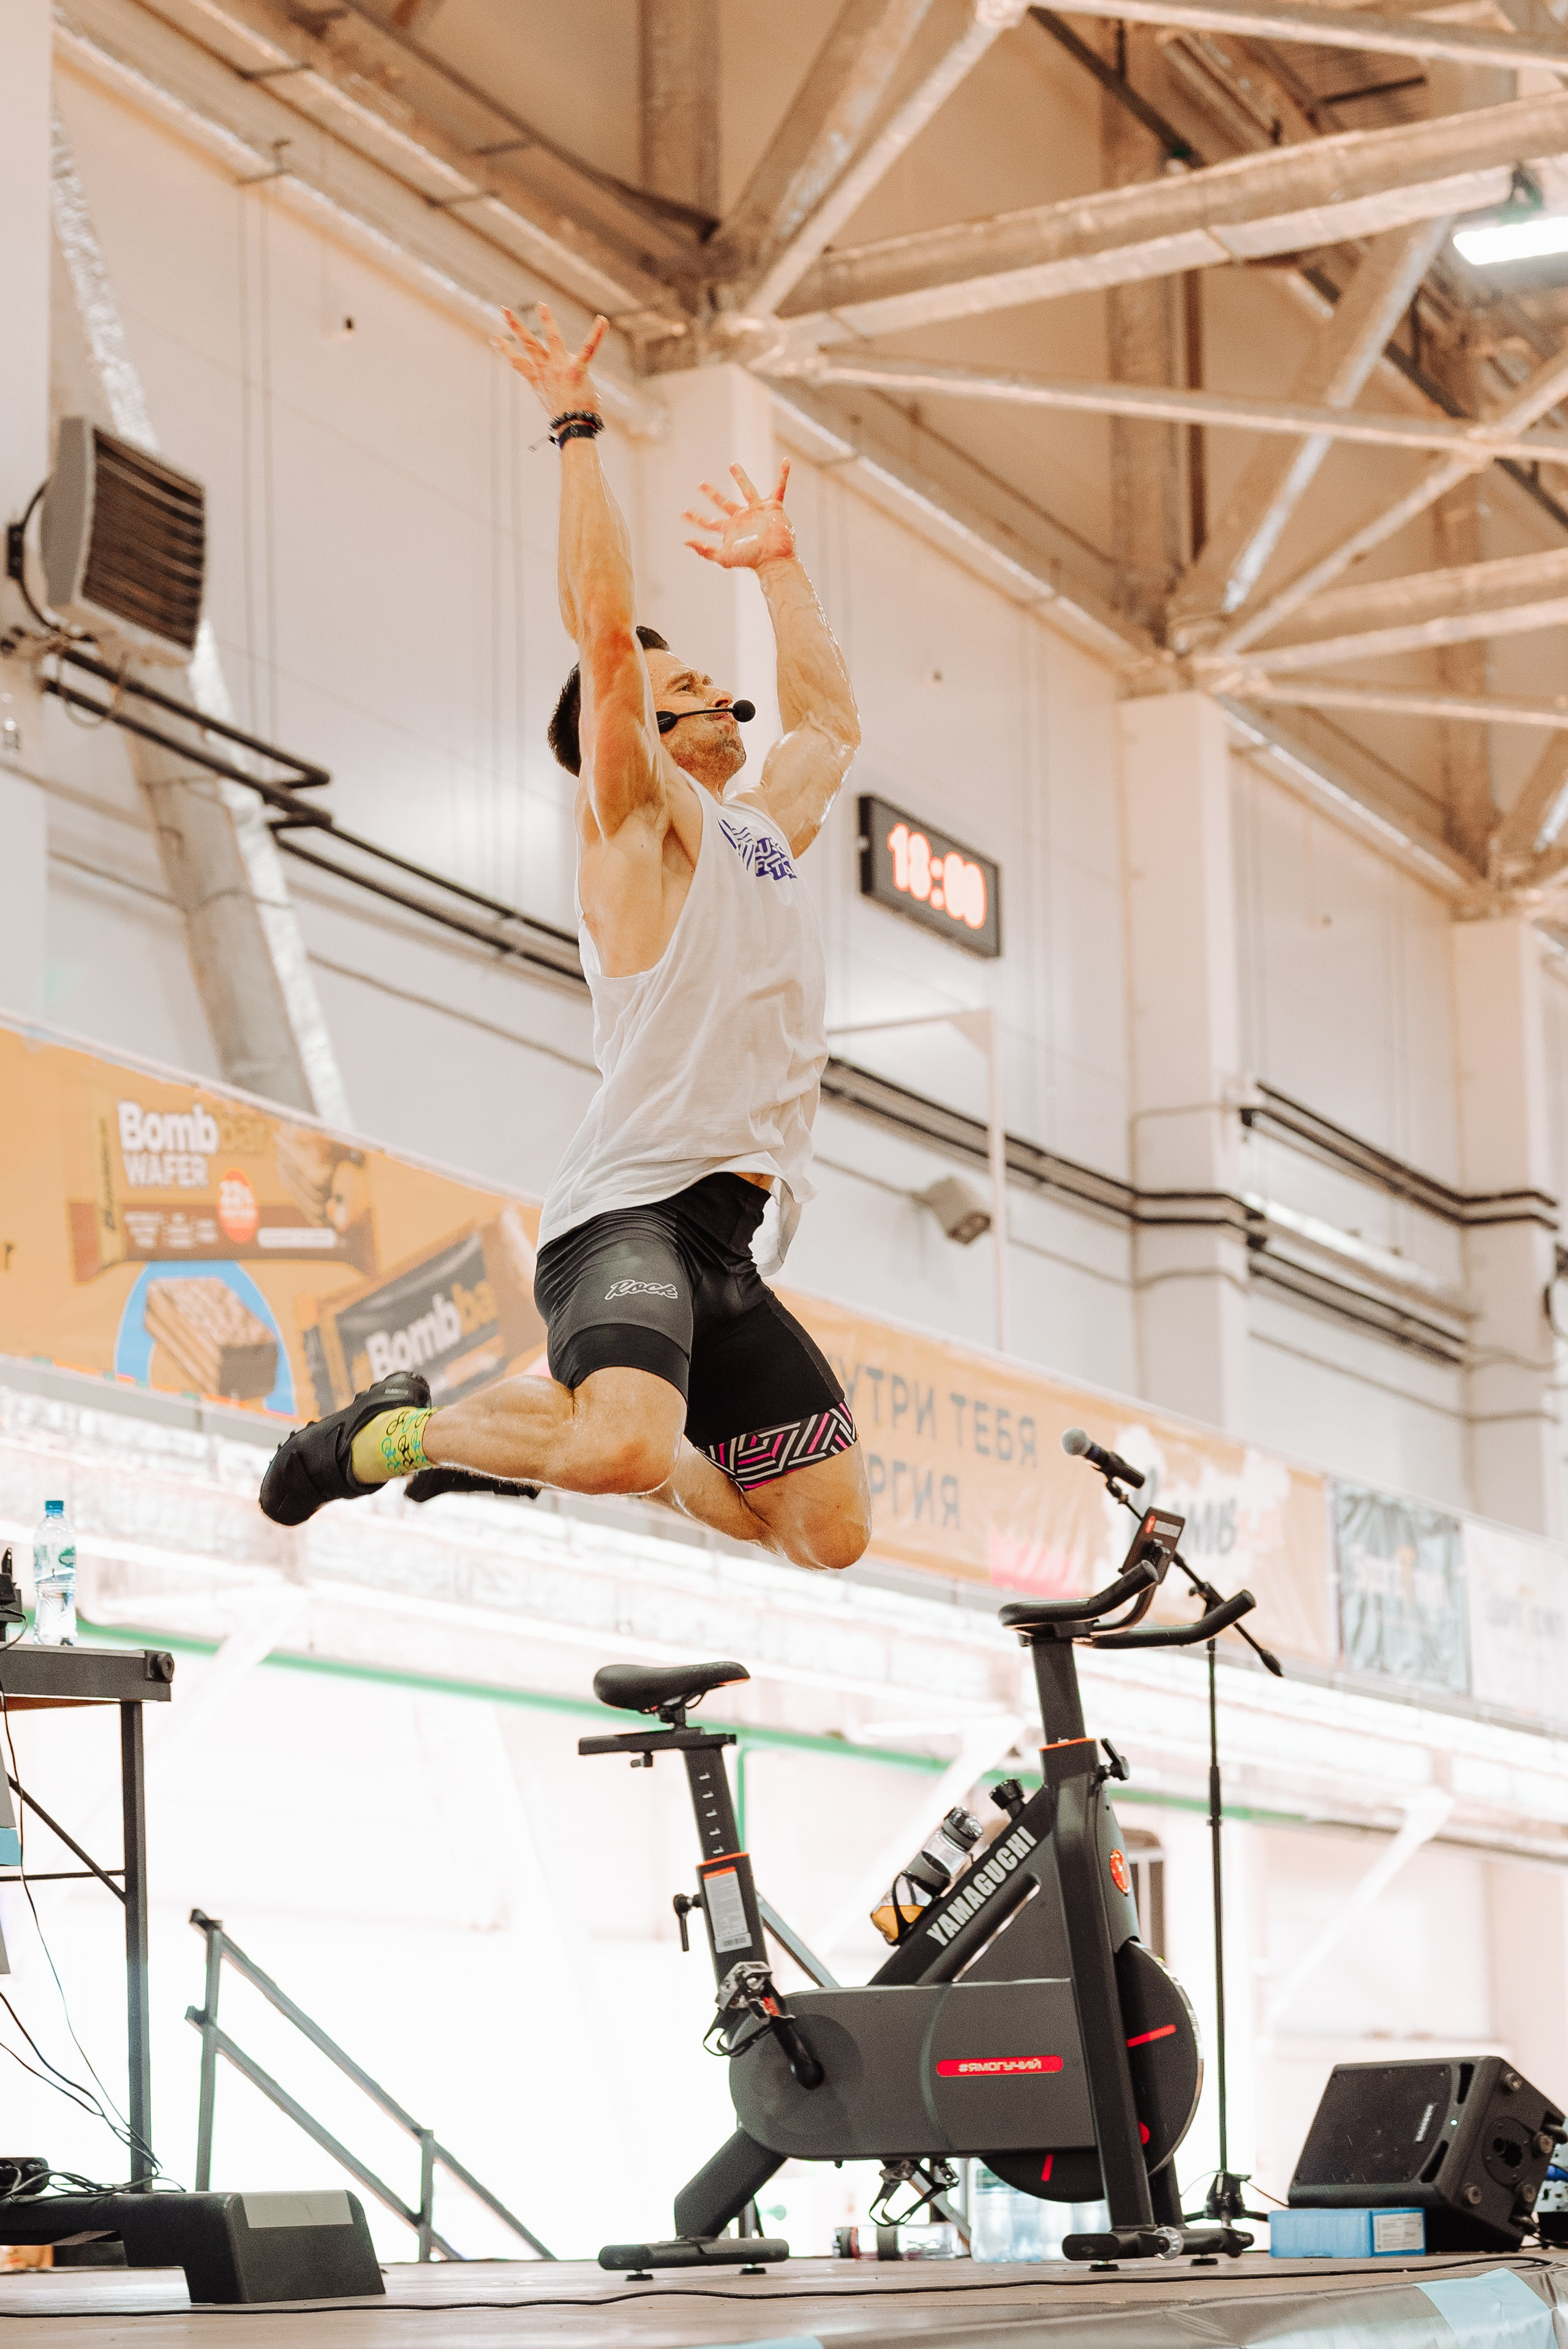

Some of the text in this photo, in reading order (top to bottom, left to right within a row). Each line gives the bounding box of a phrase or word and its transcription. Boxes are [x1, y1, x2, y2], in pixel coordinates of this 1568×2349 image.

[123, 1155, 209, 1188] WAFER
[826, 1354, 1038, 1469] УТРИ ТЕБЯ
[867, 1452, 961, 1530] РГИЯ
[926, 1826, 1037, 1946] YAMAGUCHI
